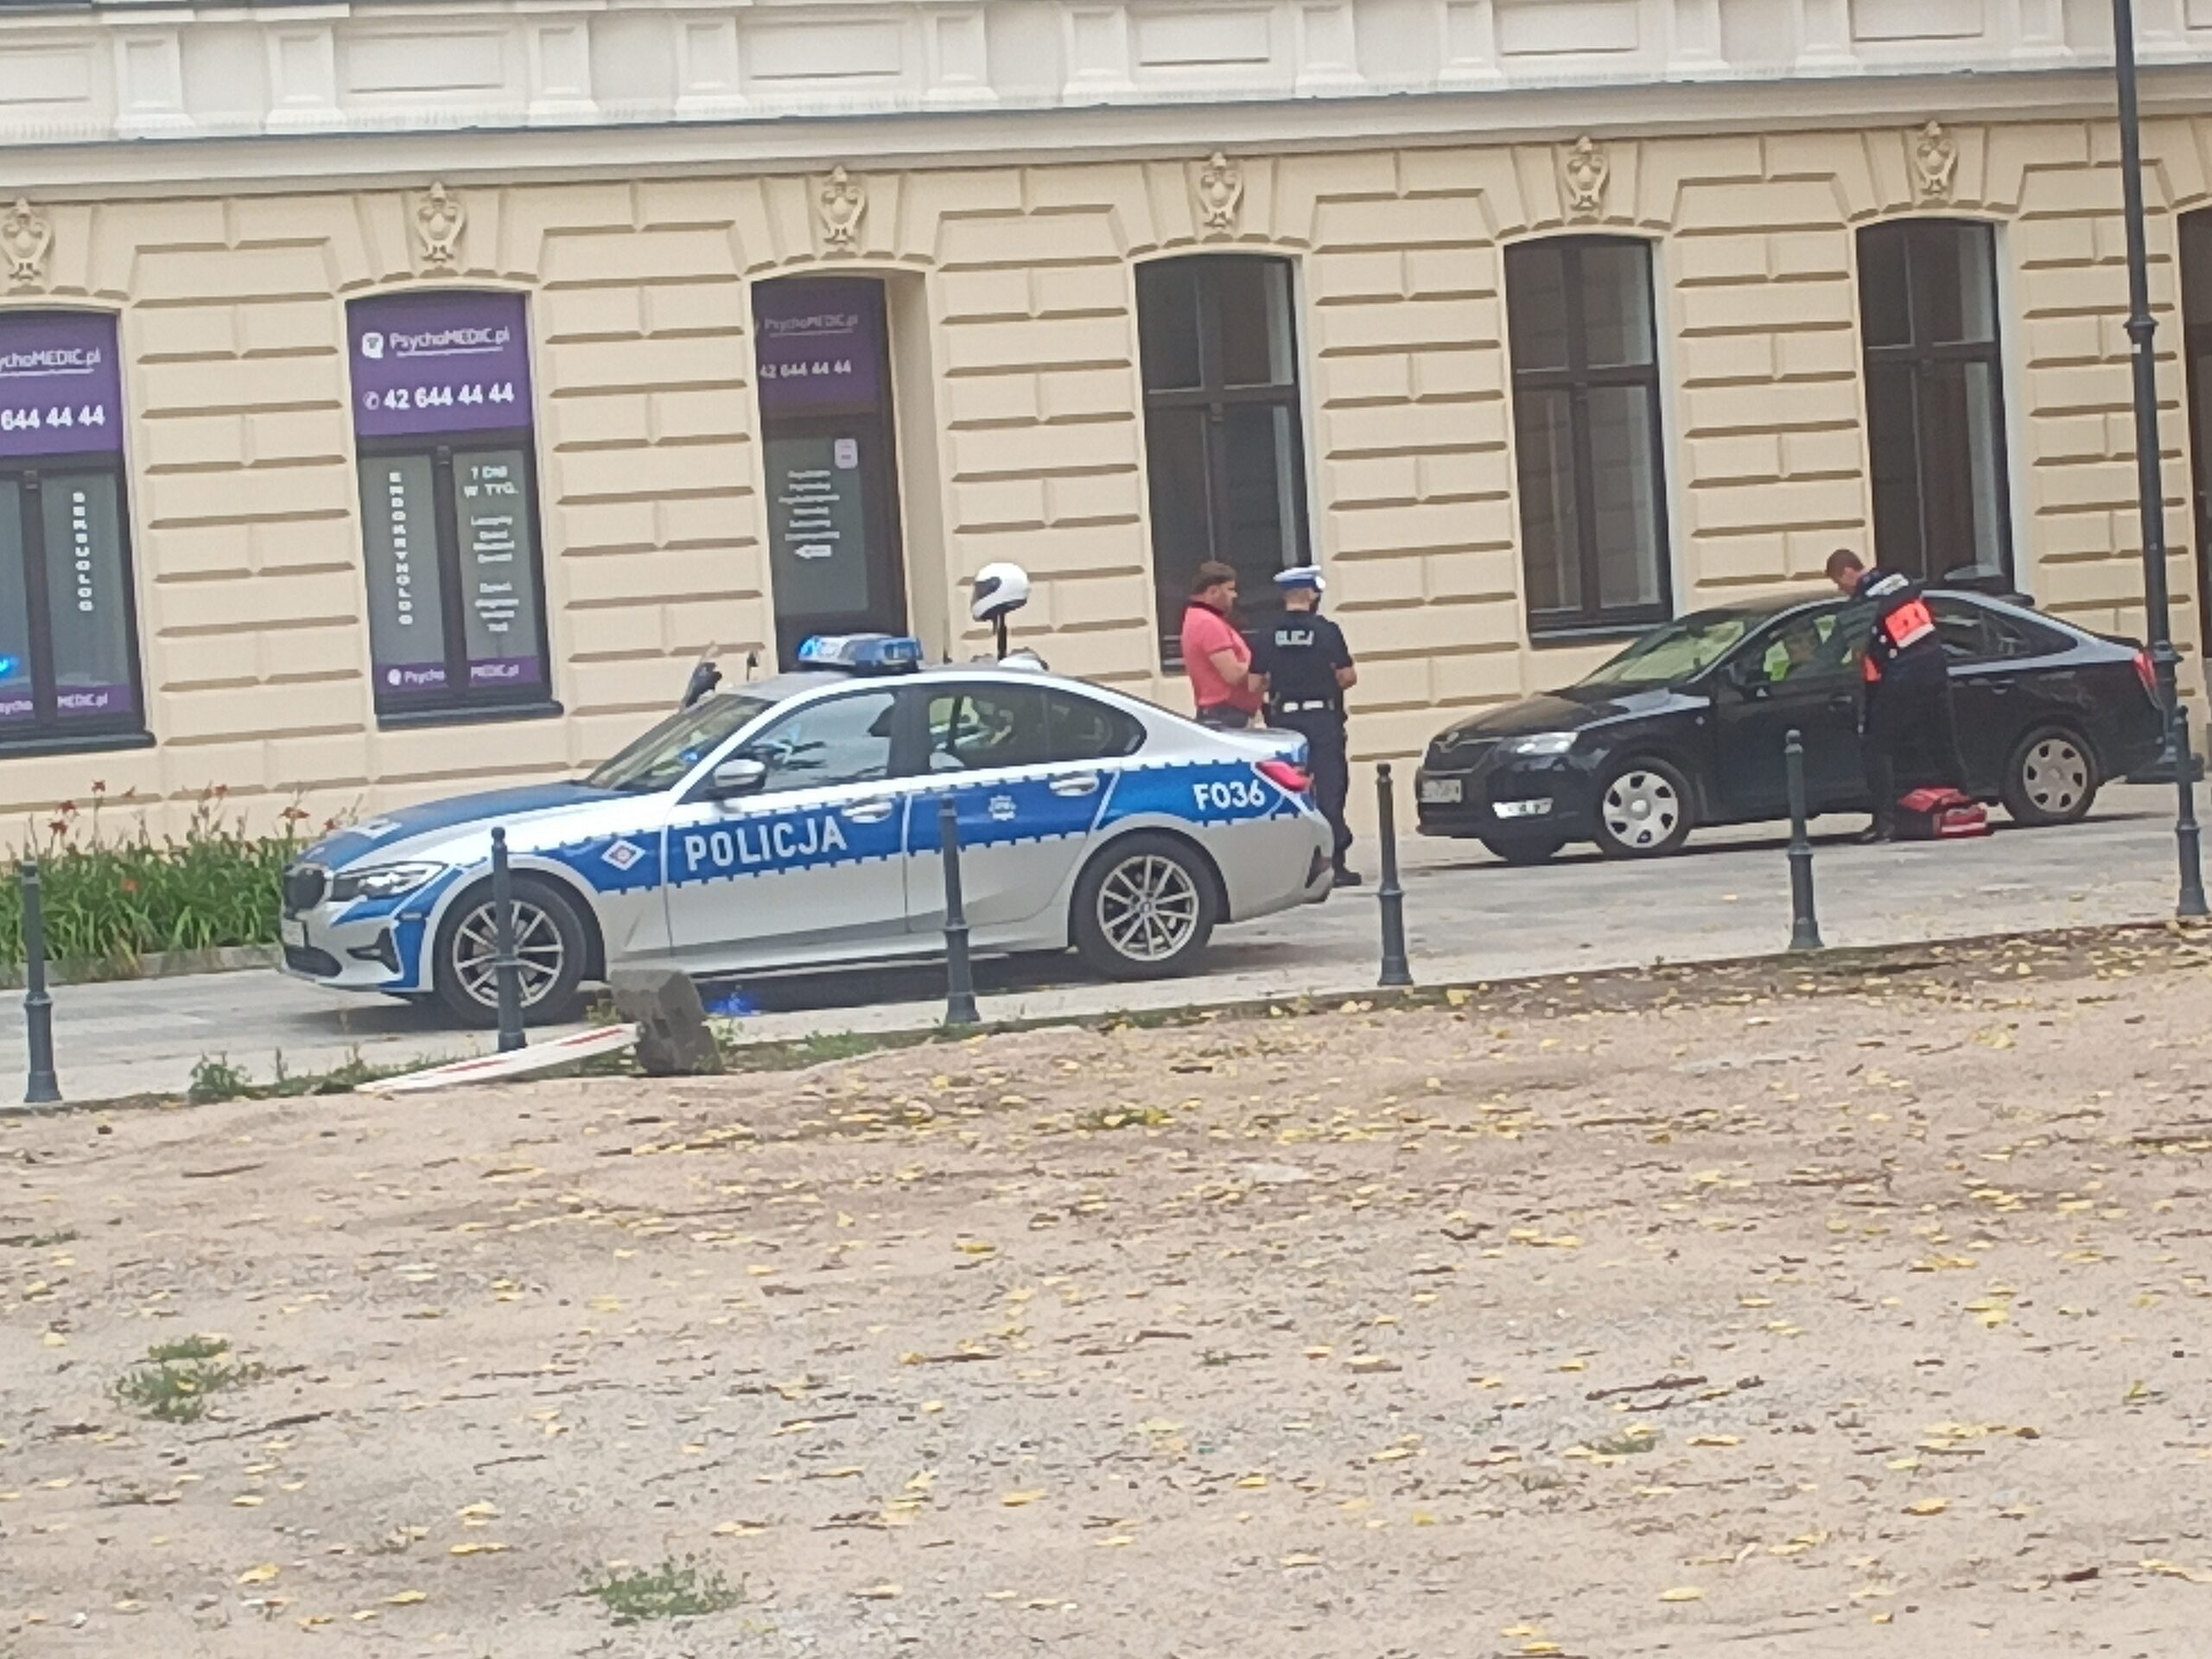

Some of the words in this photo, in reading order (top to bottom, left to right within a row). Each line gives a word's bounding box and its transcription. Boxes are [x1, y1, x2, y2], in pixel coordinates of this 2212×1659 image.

[390, 326, 511, 352] PsychoMEDIC.pl
[760, 364, 777, 378] 42
[780, 362, 808, 378] 644
[811, 362, 830, 374] 44
[833, 359, 851, 373] 44
[384, 389, 410, 410] 42
[415, 386, 454, 408] 644
[458, 384, 483, 405] 44
[488, 382, 514, 403] 44
[1, 409, 41, 430] 644
[46, 406, 73, 428] 44
[78, 404, 105, 426] 44
[1193, 783, 1265, 810] F036
[684, 816, 847, 871] POLICJA
